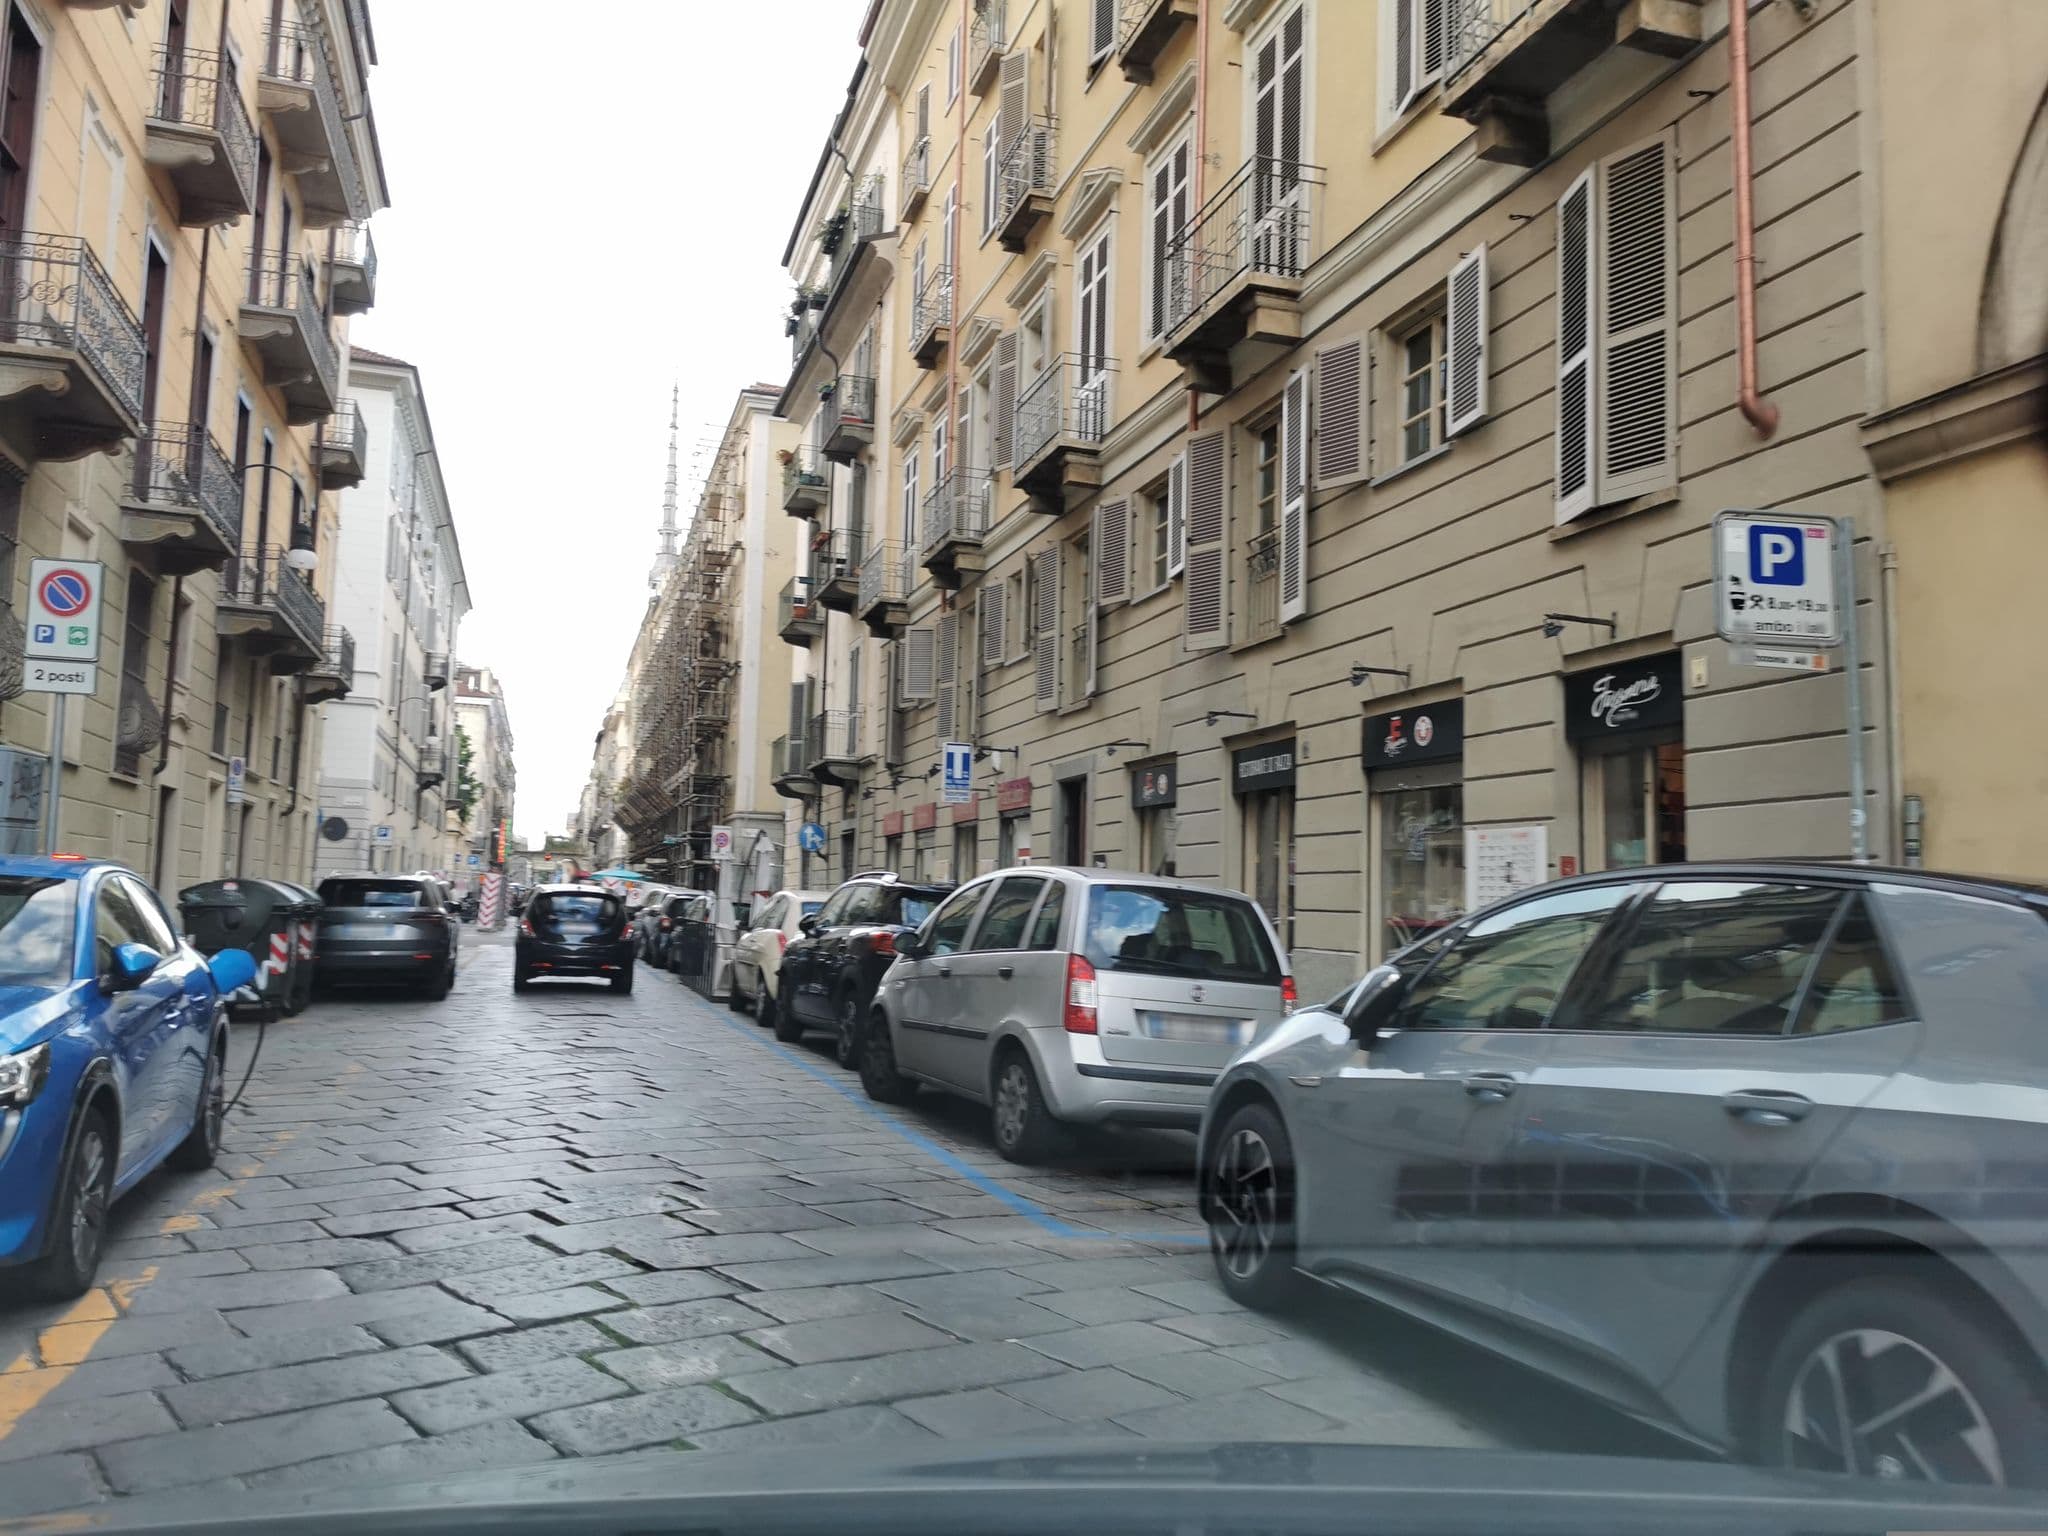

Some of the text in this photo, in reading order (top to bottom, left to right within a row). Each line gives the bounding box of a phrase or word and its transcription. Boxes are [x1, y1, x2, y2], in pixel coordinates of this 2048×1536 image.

[1760, 533, 1796, 577] P
[37, 626, 52, 641] P
[34, 669, 85, 683] 2 posti
